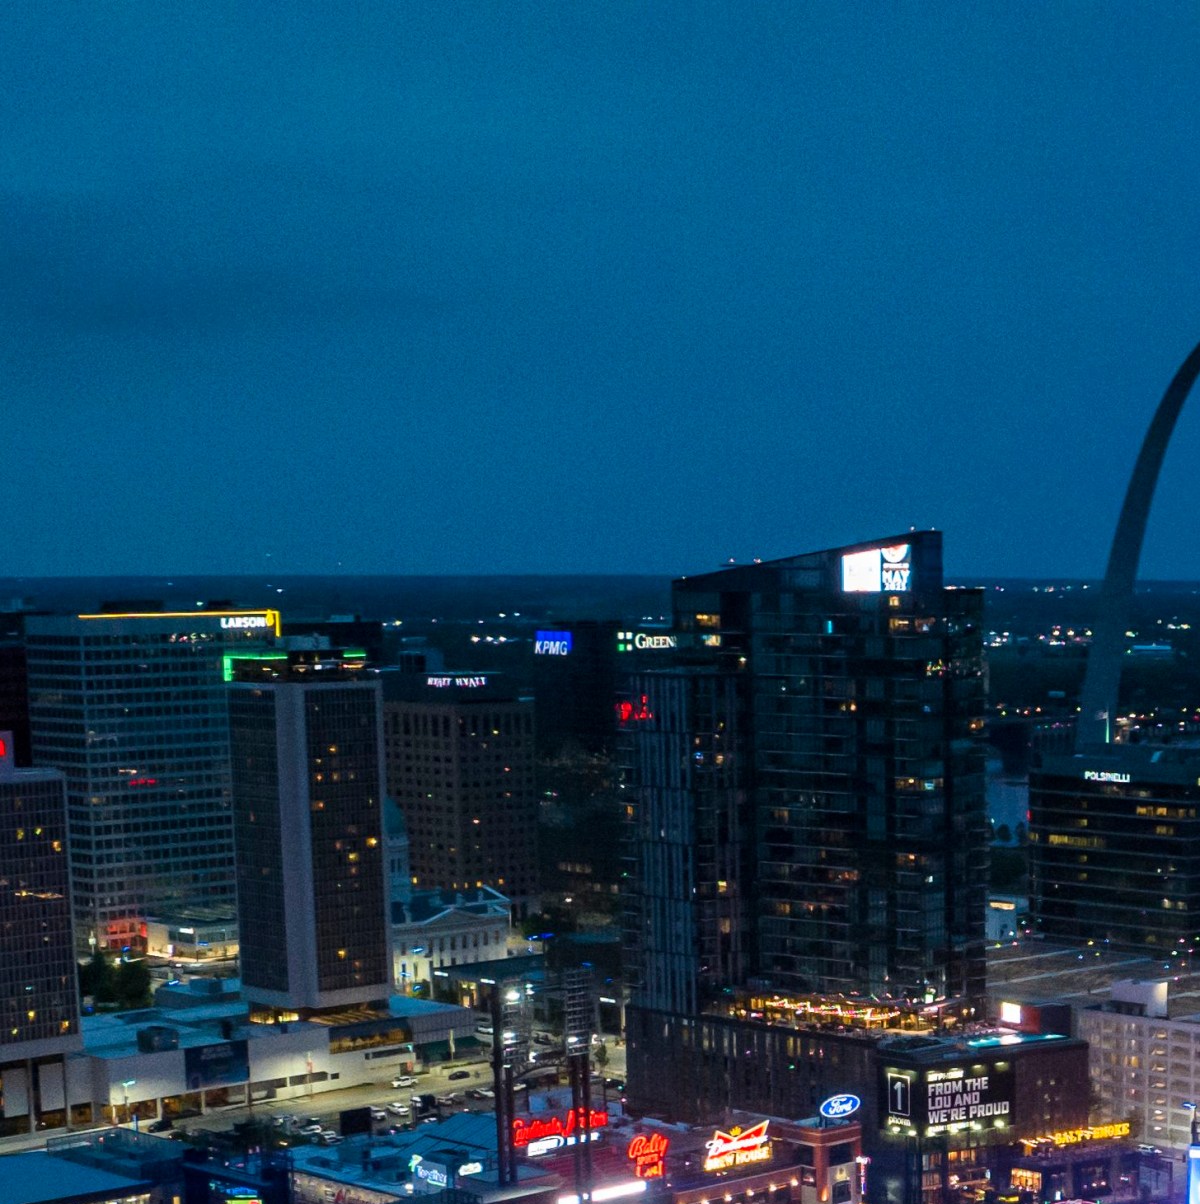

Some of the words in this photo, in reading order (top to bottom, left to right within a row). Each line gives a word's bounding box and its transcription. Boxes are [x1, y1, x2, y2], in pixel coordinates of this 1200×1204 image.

[220, 616, 266, 629] LARSON
[534, 640, 568, 656] KPMG
[1084, 770, 1131, 783] POLSINELLI
[927, 1081, 963, 1097] FROM
[965, 1076, 989, 1092] THE
[828, 1098, 853, 1114] Ford
[927, 1096, 953, 1111] LOU
[953, 1091, 980, 1107] AND
[927, 1107, 967, 1124] WE'RE
[968, 1101, 1010, 1118] PROUD
[1092, 1122, 1130, 1140] SMOKE
[628, 1132, 669, 1159] Bally
